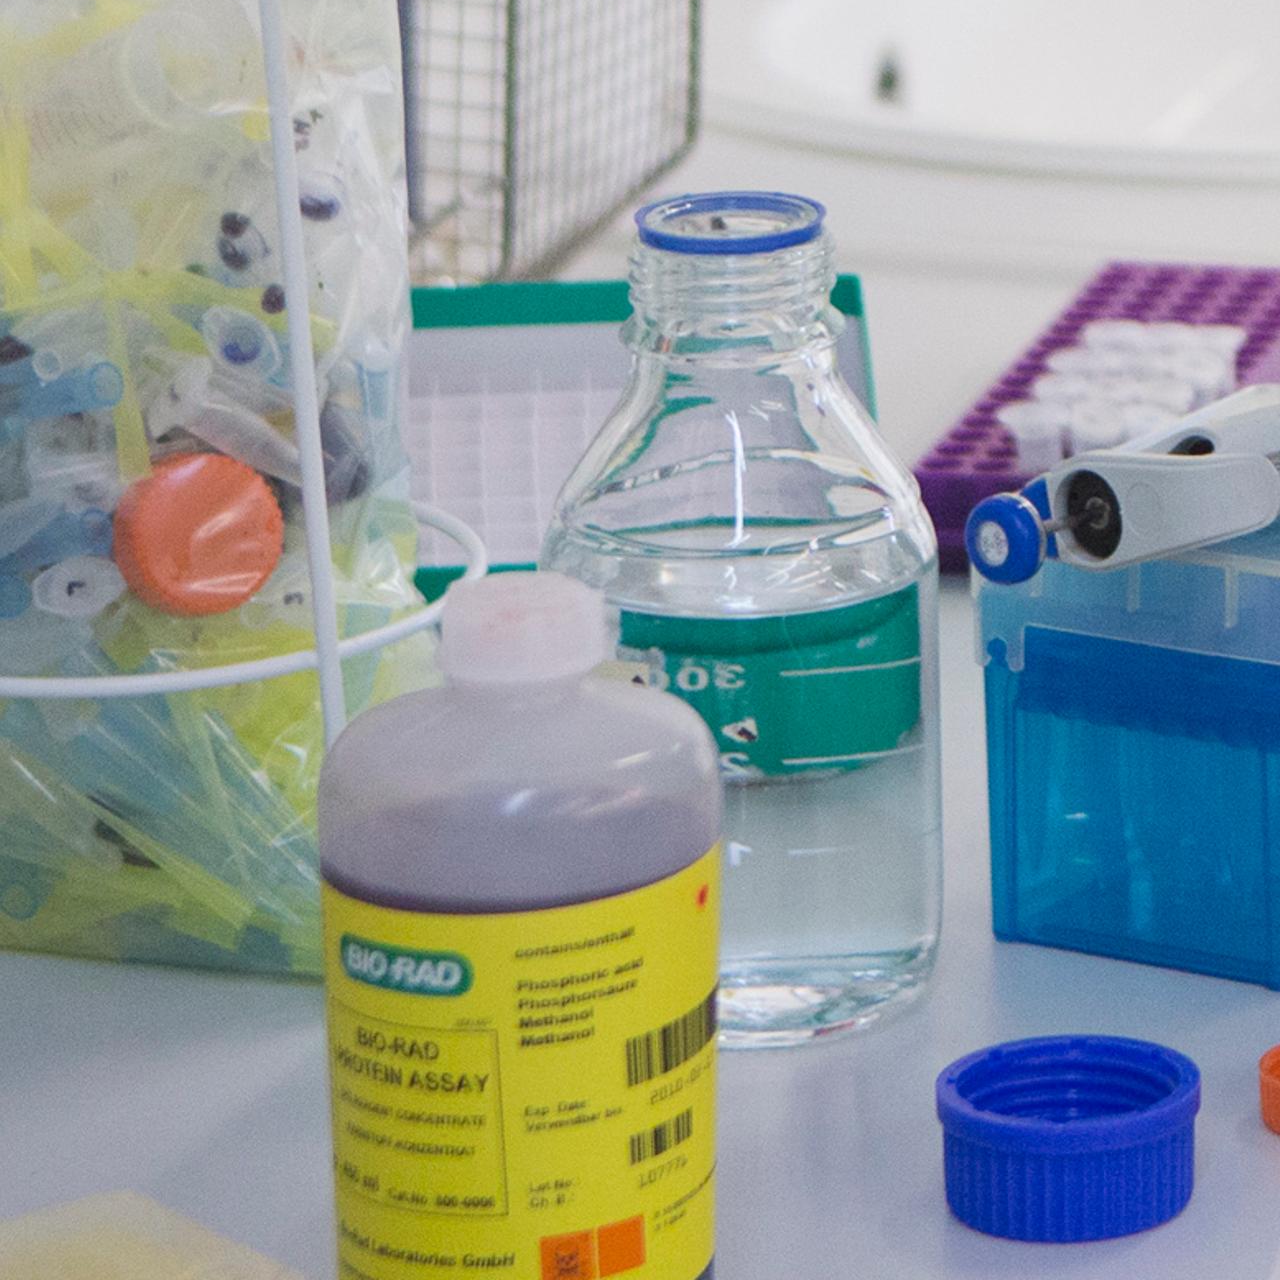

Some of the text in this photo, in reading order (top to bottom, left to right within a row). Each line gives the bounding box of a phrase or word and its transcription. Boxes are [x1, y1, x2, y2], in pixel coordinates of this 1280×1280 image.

[347, 941, 463, 989] BIO-RAD
[517, 968, 609, 992] Phosphoric
[519, 1007, 595, 1029] Methanol
[356, 1024, 440, 1061] BIO-RAD
[520, 1025, 595, 1047] Methanol
[408, 1069, 490, 1093] ASSAY
[462, 1251, 516, 1269] GmbH
